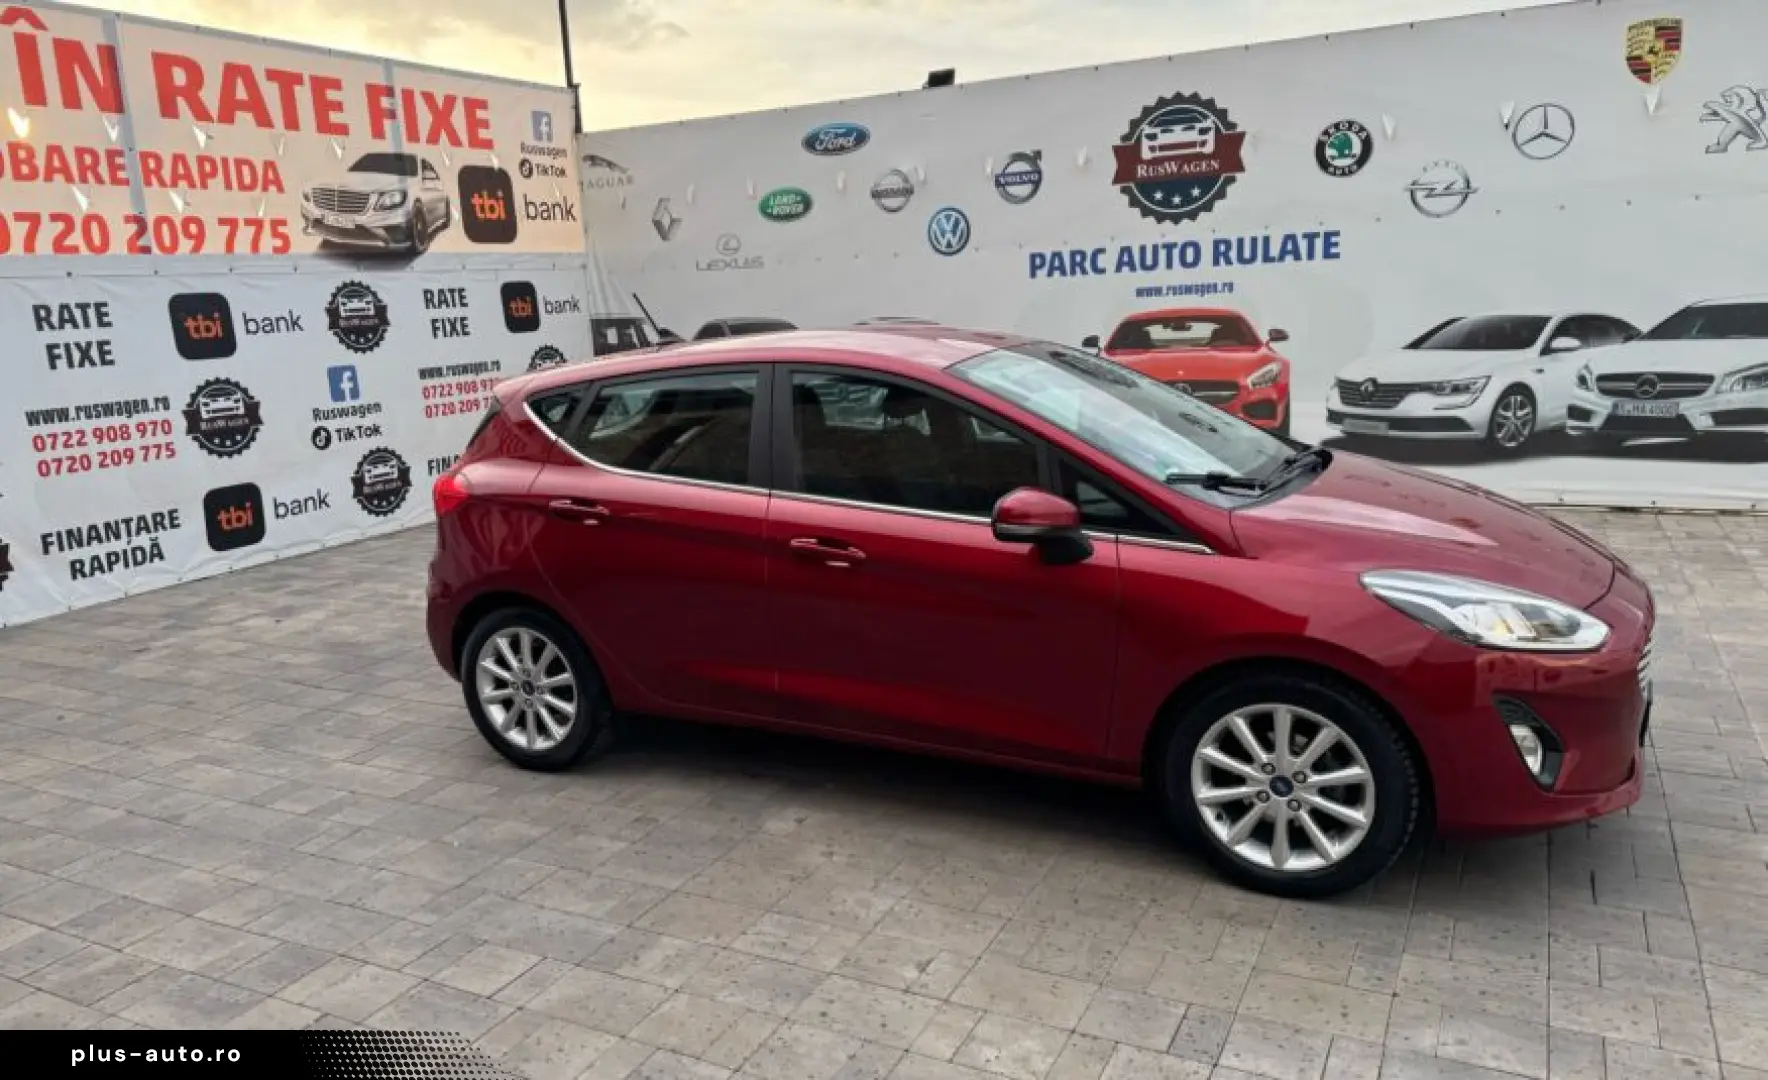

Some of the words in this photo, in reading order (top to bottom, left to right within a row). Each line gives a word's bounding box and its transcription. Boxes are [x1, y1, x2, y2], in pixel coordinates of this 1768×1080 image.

[151, 51, 350, 136] RATE
[365, 82, 495, 150] FIXE
[815, 129, 858, 150] Ford
[0, 141, 130, 187] BARE
[139, 150, 285, 194] RAPIDA
[535, 162, 568, 178] TikTok
[998, 172, 1039, 184] VOLVO
[472, 190, 506, 220] tbi
[524, 194, 577, 222] bank
[124, 215, 206, 256] 209
[217, 217, 291, 255] 775
[696, 255, 765, 272] LEXUS
[1029, 247, 1107, 279] PARC
[1114, 240, 1202, 274] AUTO
[1212, 230, 1341, 268] RULATE
[422, 287, 469, 310] RATE
[1135, 281, 1234, 298] www.ruswagen.ro
[32, 302, 113, 331] RATE
[509, 296, 534, 318] tbi
[543, 294, 582, 315] bank
[184, 312, 223, 340] tbi
[242, 309, 304, 335] bank
[430, 316, 471, 339] FIXE
[45, 340, 115, 370] FIXE
[422, 380, 453, 400] 0722
[455, 378, 479, 396] 908
[481, 374, 499, 392] 97
[25, 396, 171, 427] www.ruswagen.ro
[312, 401, 382, 422] Ruswagen
[424, 402, 456, 419] 0720
[459, 397, 482, 416] 209
[32, 429, 89, 453] 0722
[92, 423, 132, 446] 908
[135, 418, 173, 439] 970
[335, 423, 383, 444] TikTok
[37, 453, 92, 478] 0720
[98, 447, 135, 470] 209
[140, 441, 177, 461] 775
[218, 503, 253, 530] tbi
[273, 488, 331, 519] bank
[69, 537, 165, 581] RAPIDĂ
